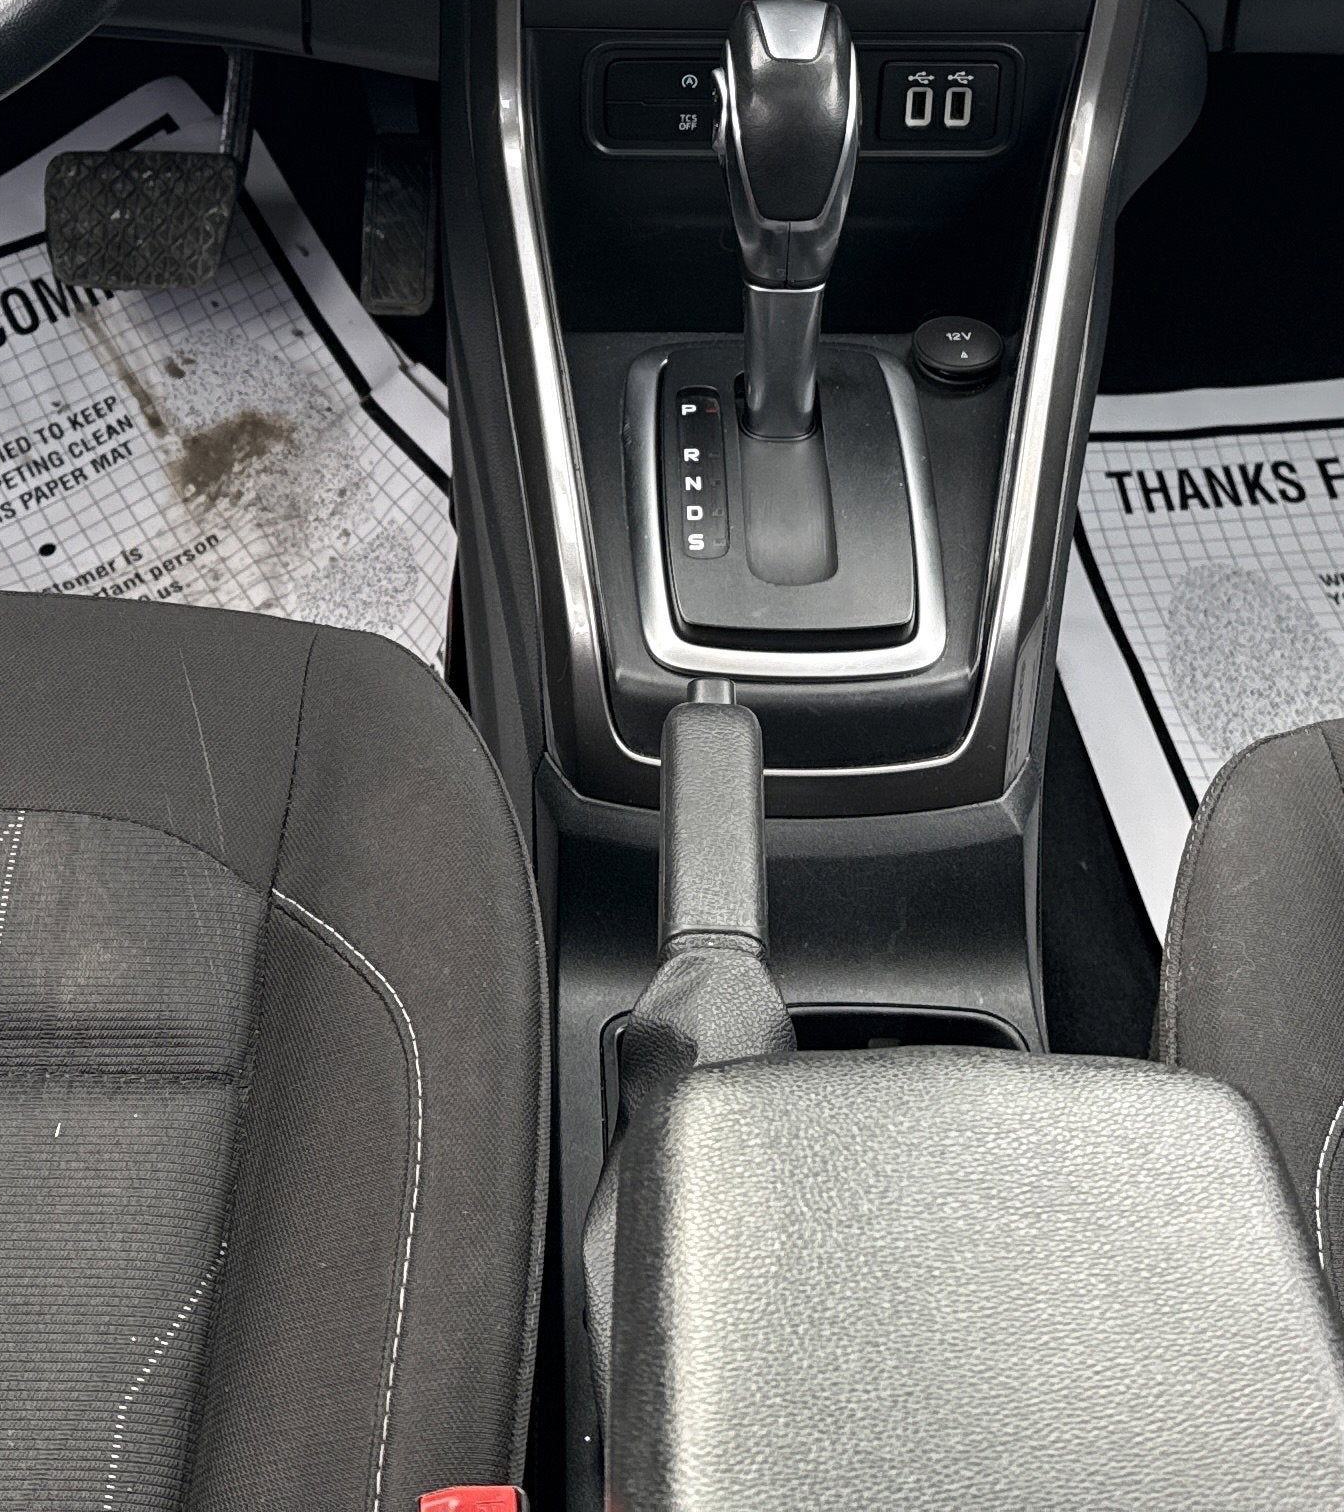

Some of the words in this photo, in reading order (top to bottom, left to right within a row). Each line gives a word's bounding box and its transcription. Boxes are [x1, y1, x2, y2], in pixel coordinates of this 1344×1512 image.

[680, 114, 697, 122] TCS
[946, 332, 971, 340] 12V
[682, 405, 696, 415] P
[37, 425, 66, 452] TO
[68, 395, 118, 439] KEEP
[68, 413, 133, 457] CLEAN
[684, 449, 699, 461] R
[17, 468, 87, 517] PAPER
[88, 441, 136, 483] MAT
[685, 476, 701, 490] N
[1106, 460, 1306, 515] THANKS
[687, 506, 703, 520] D
[688, 534, 704, 550] S
[149, 532, 220, 582] person
